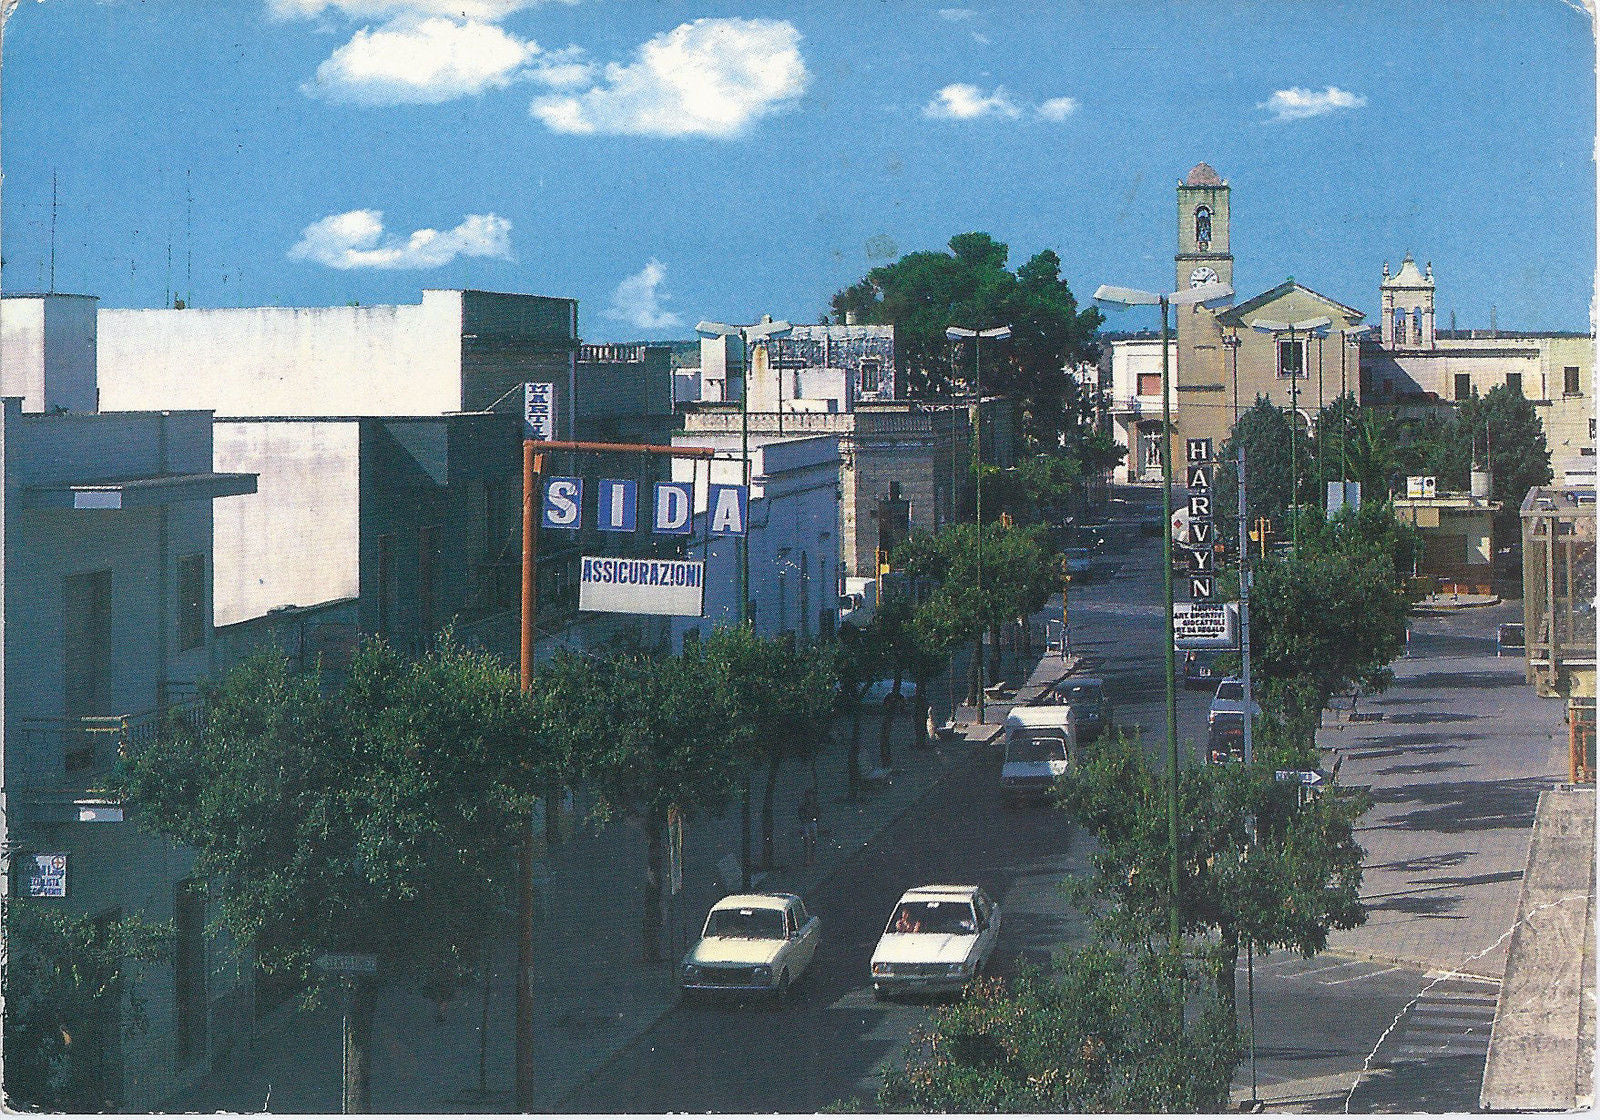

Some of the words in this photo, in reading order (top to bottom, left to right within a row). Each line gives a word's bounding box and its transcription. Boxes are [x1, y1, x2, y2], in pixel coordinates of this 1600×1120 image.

[547, 481, 743, 533] SIDA
[1190, 442, 1210, 597] HARVYN
[582, 559, 701, 588] ASSICURAZIONI
